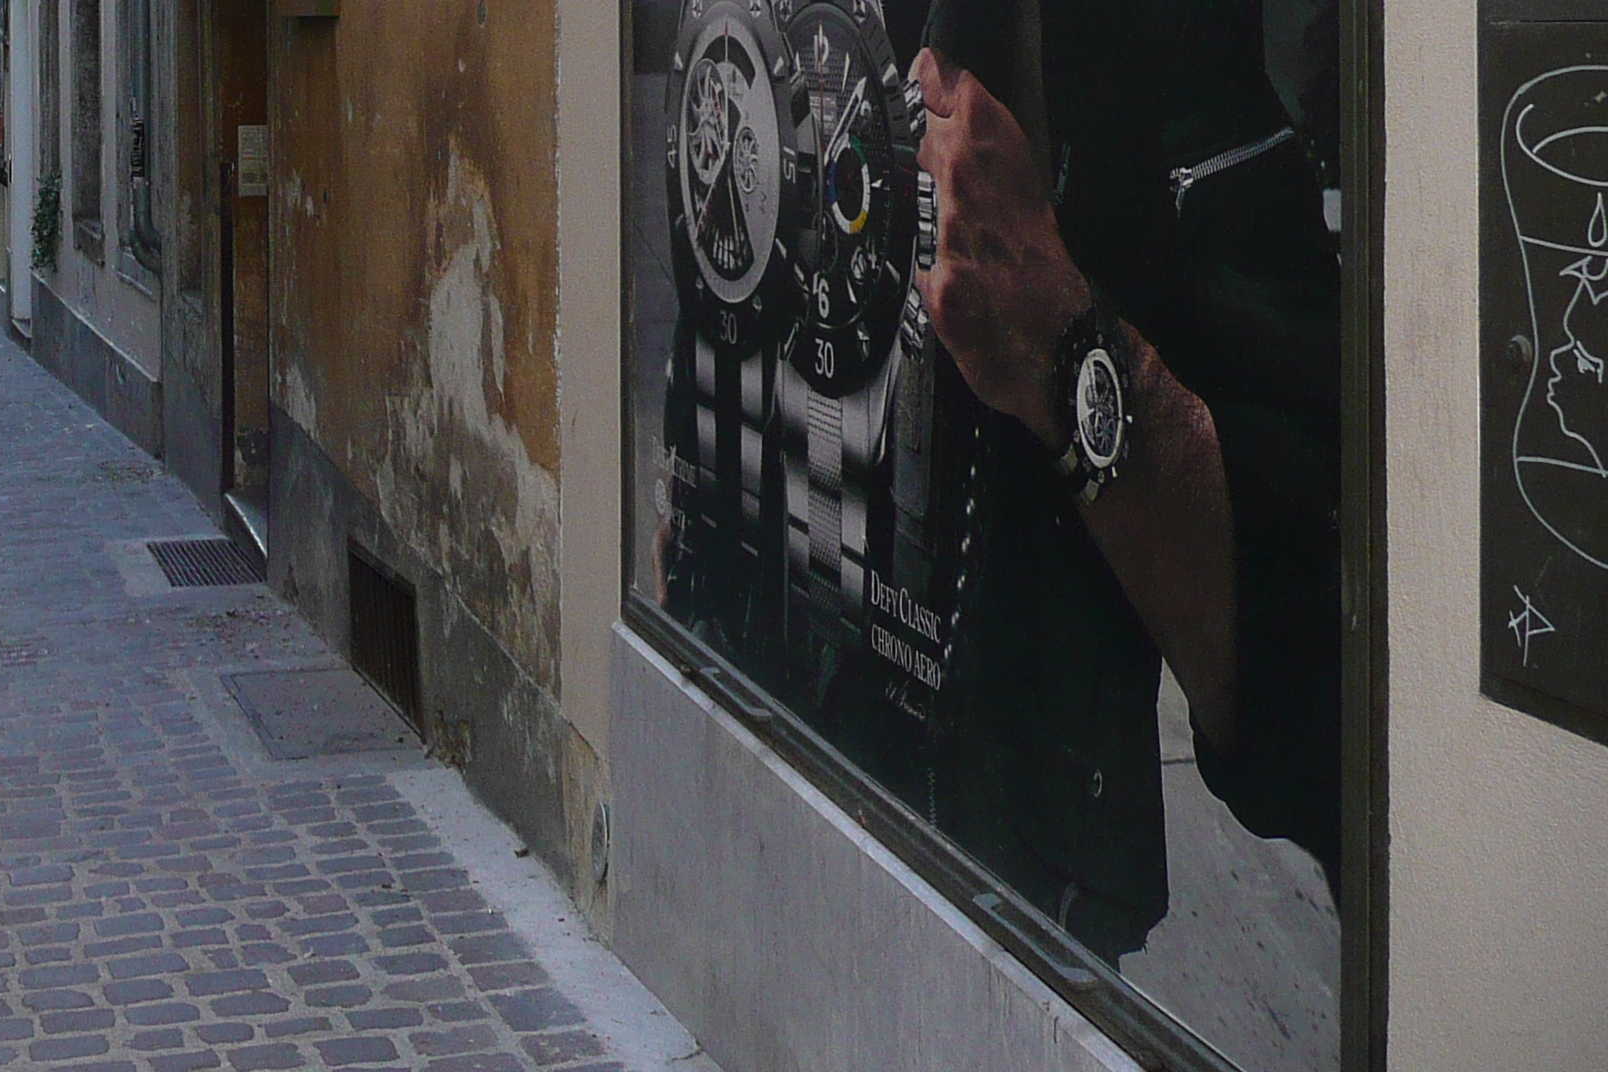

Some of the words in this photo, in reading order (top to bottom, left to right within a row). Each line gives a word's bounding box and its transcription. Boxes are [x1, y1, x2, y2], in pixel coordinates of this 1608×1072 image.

[818, 278, 830, 319] 6
[720, 309, 738, 345] 30
[814, 337, 835, 379] 30
[870, 569, 898, 618] DEFY
[899, 587, 941, 644] CLASSIC
[871, 623, 912, 673] CHRONO
[913, 650, 941, 691] AERO
